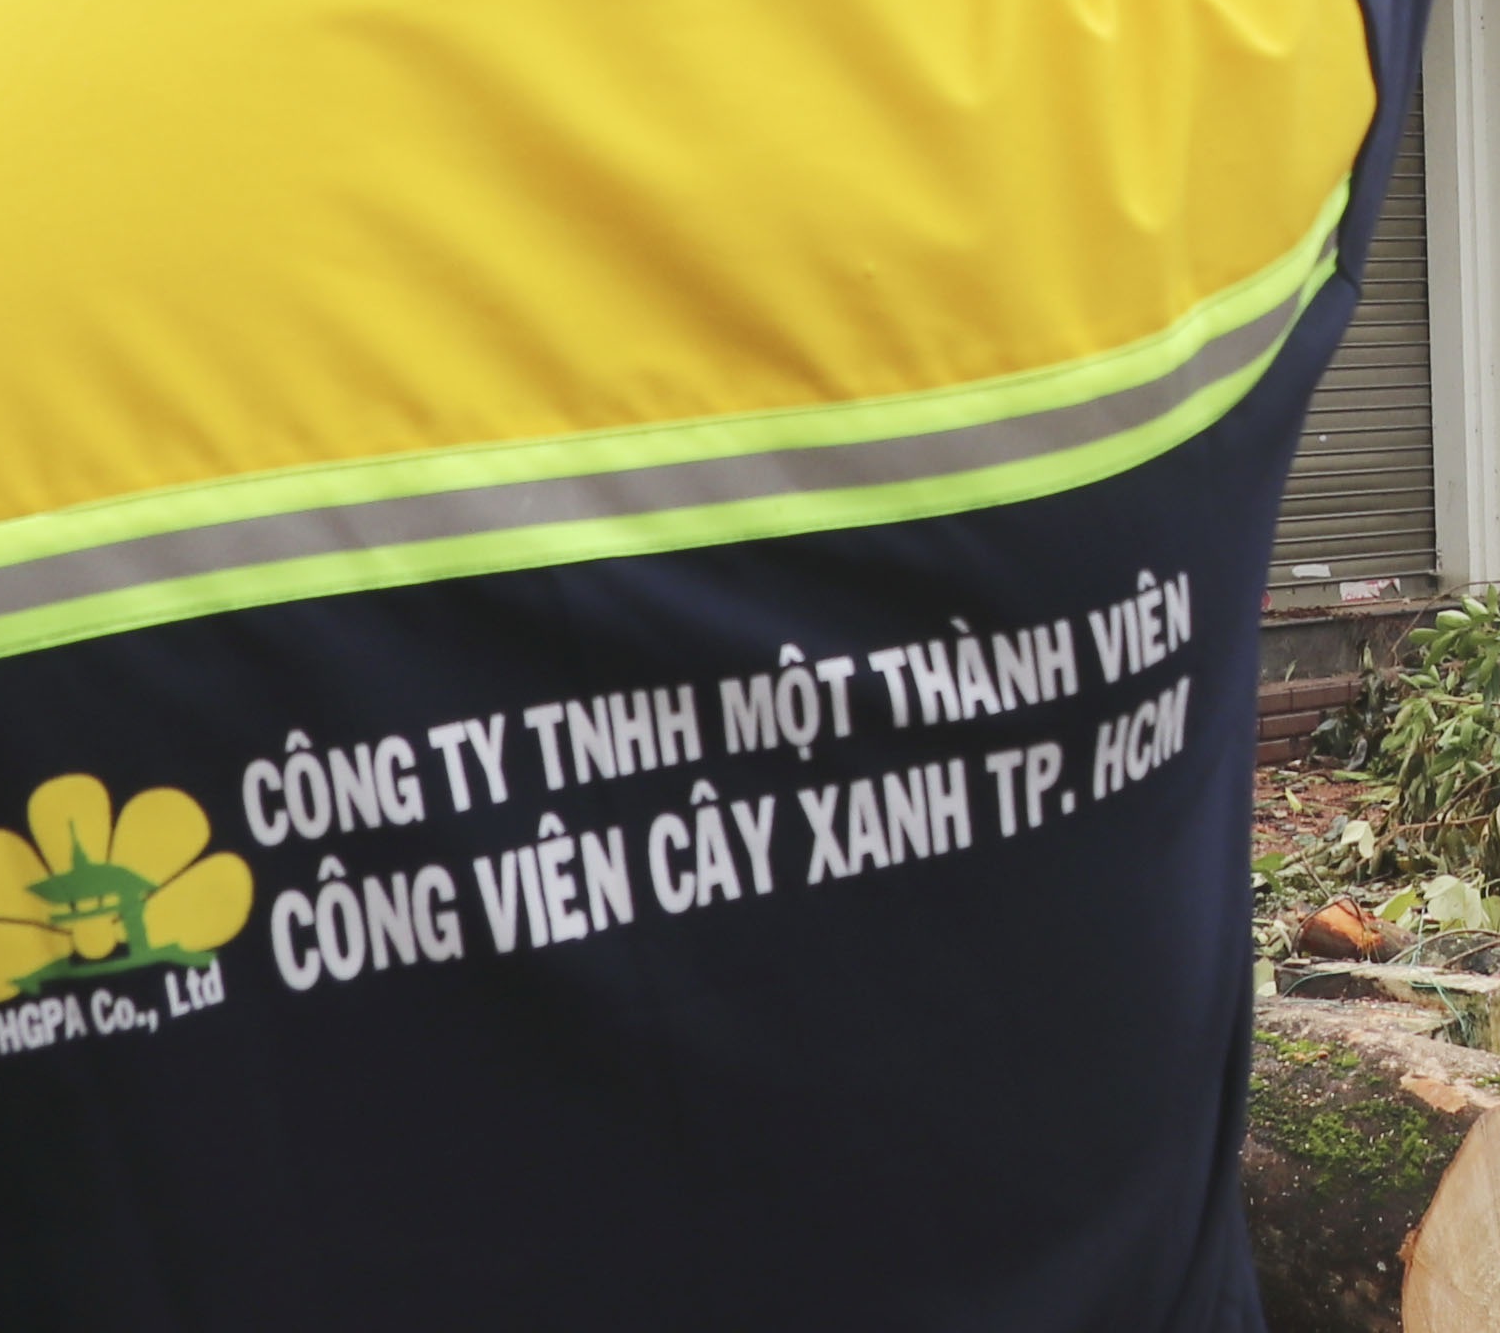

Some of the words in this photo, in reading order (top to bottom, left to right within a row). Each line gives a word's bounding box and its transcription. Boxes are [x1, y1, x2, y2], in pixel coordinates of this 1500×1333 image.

[243, 729, 425, 846] CÔNG
[428, 714, 509, 812] TY
[523, 683, 702, 790] TNHH
[719, 643, 855, 761] MỘT
[868, 616, 1078, 728] THÀNH
[1087, 568, 1191, 684] VIÊN
[271, 855, 464, 990] CÔNG
[473, 813, 634, 953] VIÊN
[648, 780, 776, 914] CÂY
[798, 758, 972, 885] XANH
[986, 741, 1076, 838] TP.
[1093, 676, 1191, 800] HCM
[90, 988, 159, 1033] Co.,
[164, 956, 225, 1018] Ltd
